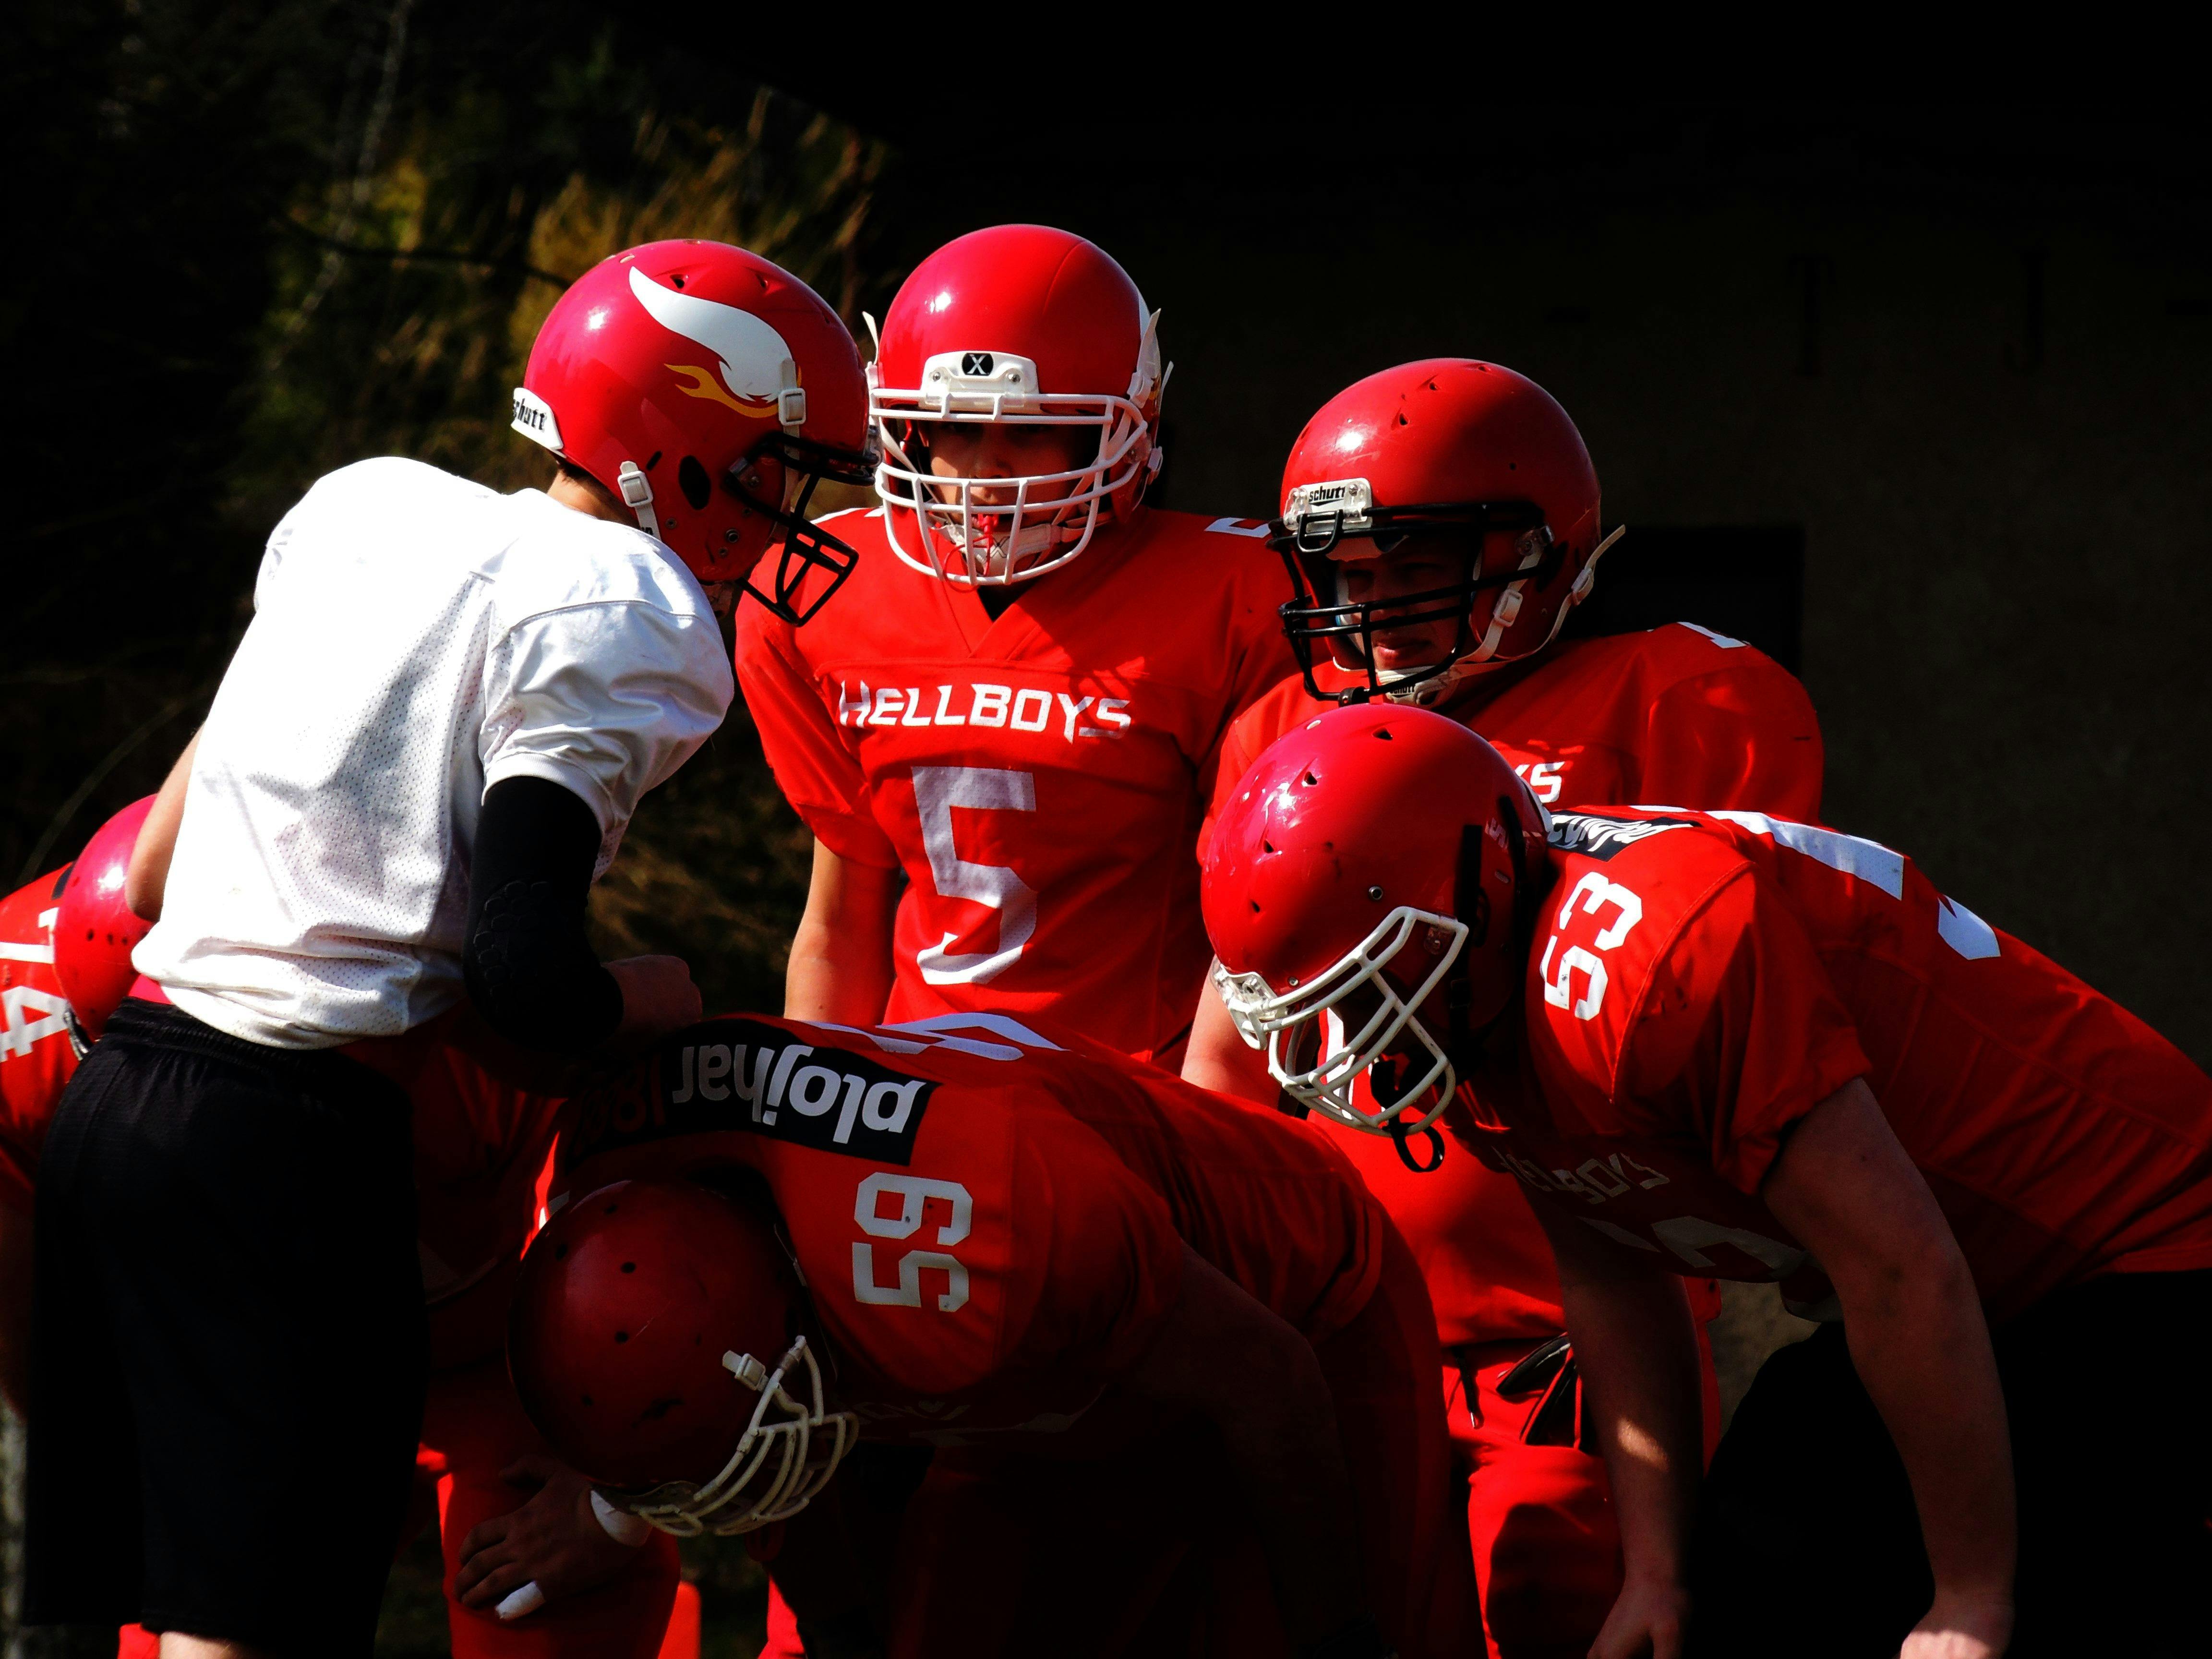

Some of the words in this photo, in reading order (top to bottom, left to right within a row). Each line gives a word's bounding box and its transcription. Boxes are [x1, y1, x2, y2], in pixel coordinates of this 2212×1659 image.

[513, 398, 547, 431] chutt
[839, 679, 1132, 745] HELLBOYS
[911, 766, 1038, 985] 5
[1539, 871, 1643, 1021] 53
[672, 1045, 927, 1145] plojhar
